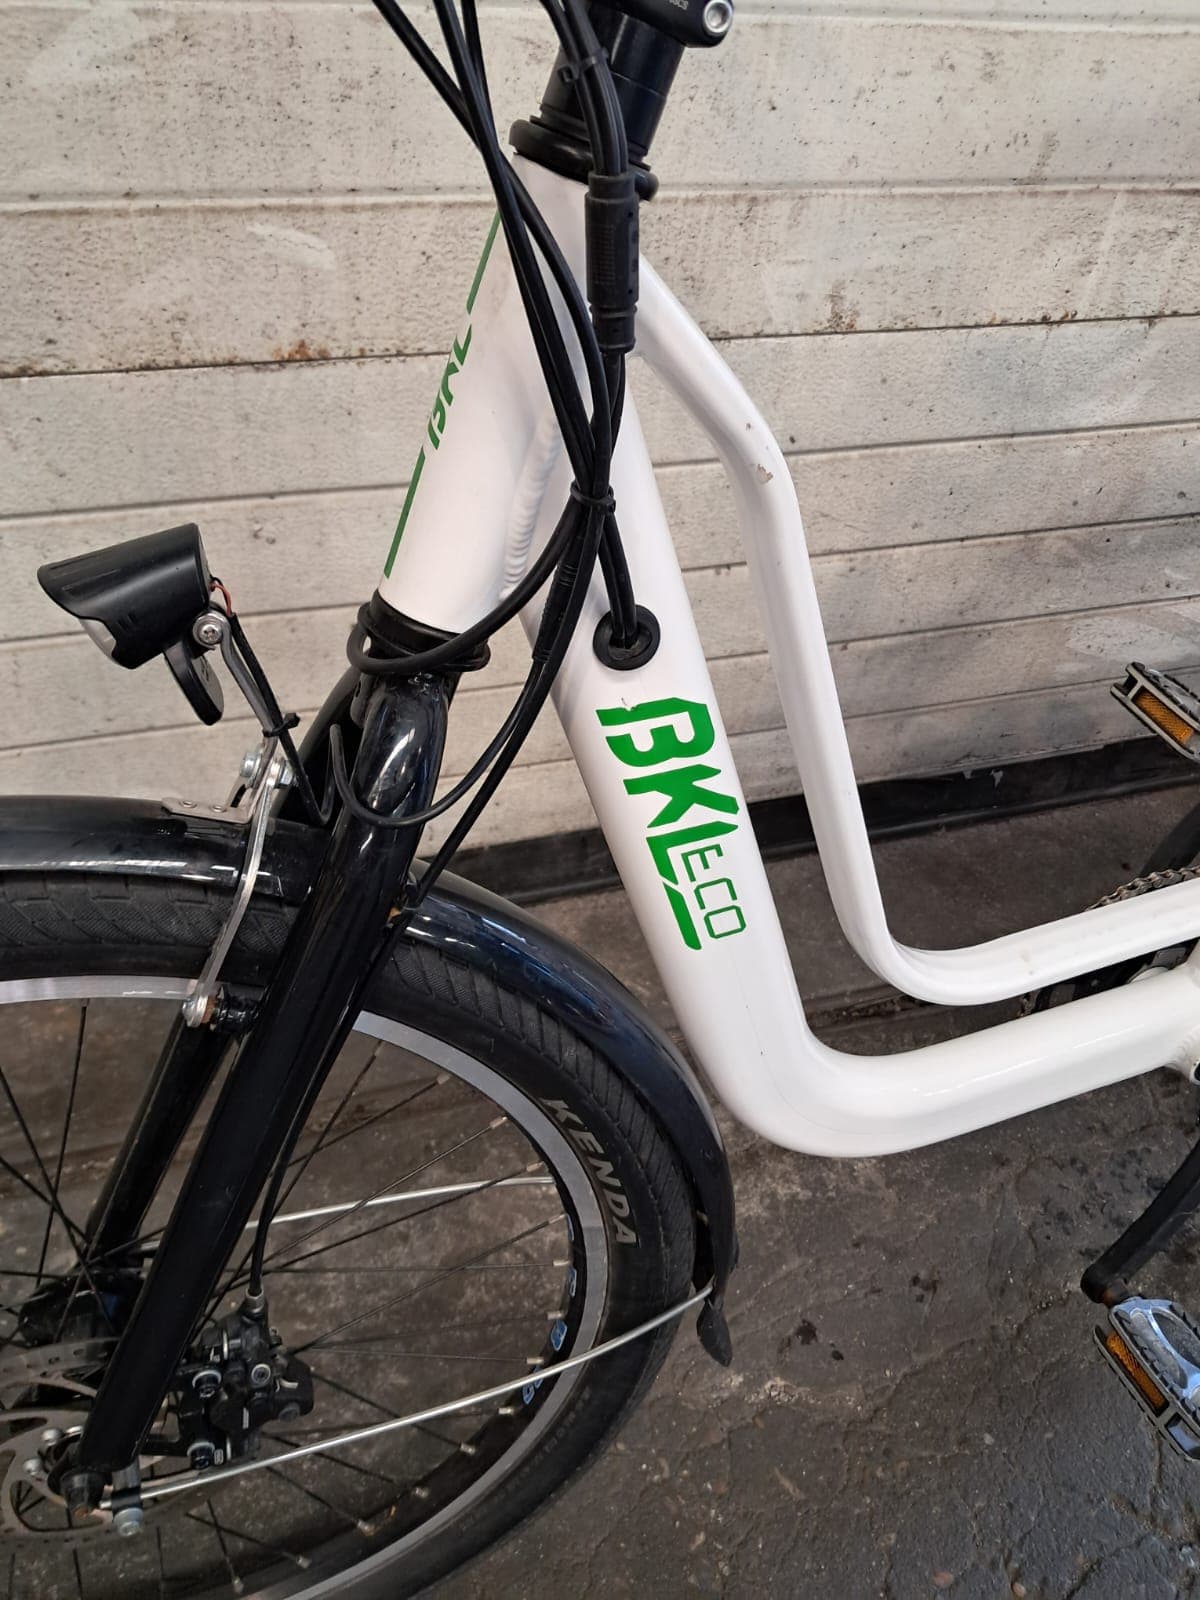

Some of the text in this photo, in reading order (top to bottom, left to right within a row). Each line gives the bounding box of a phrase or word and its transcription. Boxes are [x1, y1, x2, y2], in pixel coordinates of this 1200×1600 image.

[595, 696, 740, 950] BKL
[680, 843, 746, 939] ECO
[541, 1098, 638, 1245] KENDA
